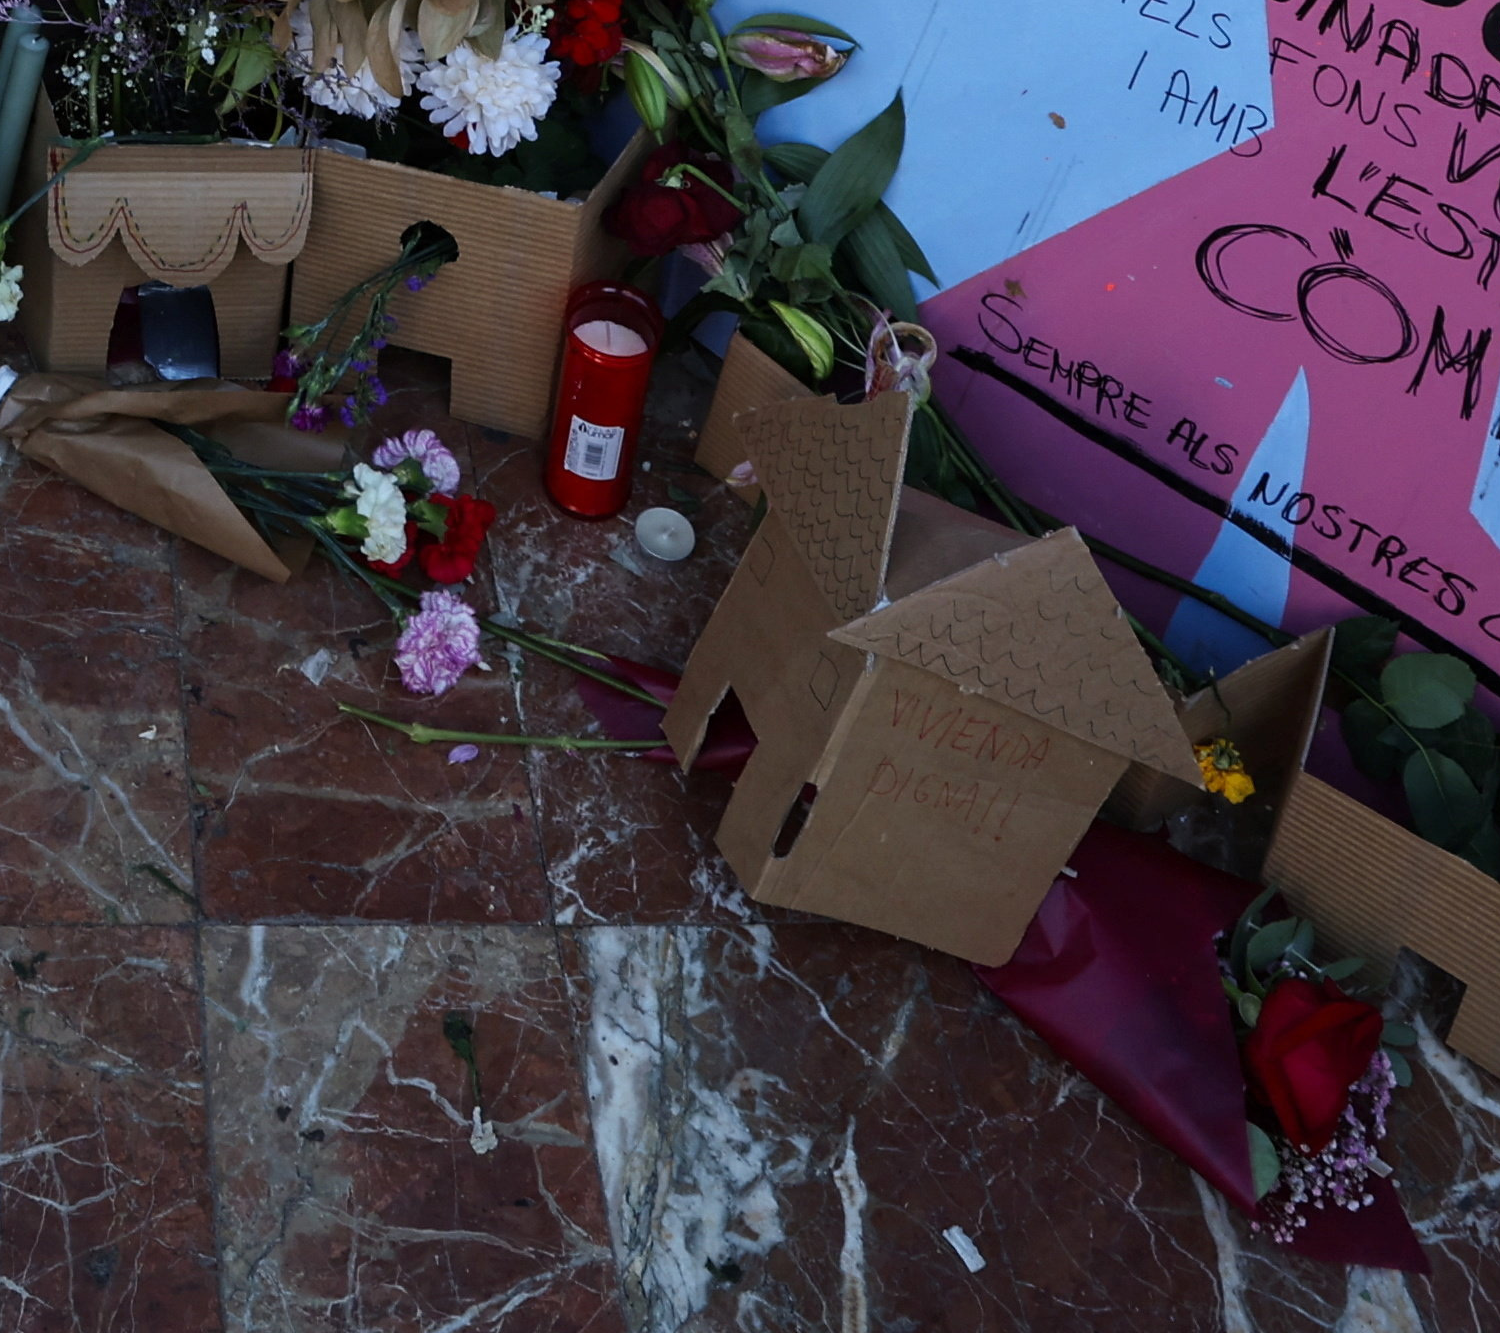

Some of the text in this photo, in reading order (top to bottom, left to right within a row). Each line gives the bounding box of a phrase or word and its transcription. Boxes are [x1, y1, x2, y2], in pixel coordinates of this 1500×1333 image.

[1159, 68, 1270, 159] AMB
[1267, 38, 1422, 148] FONS
[976, 292, 1152, 429] SEMPRE
[1165, 417, 1241, 476] ALS
[1247, 470, 1477, 617] NOSTRES
[891, 689, 1051, 770] VIVIENDA
